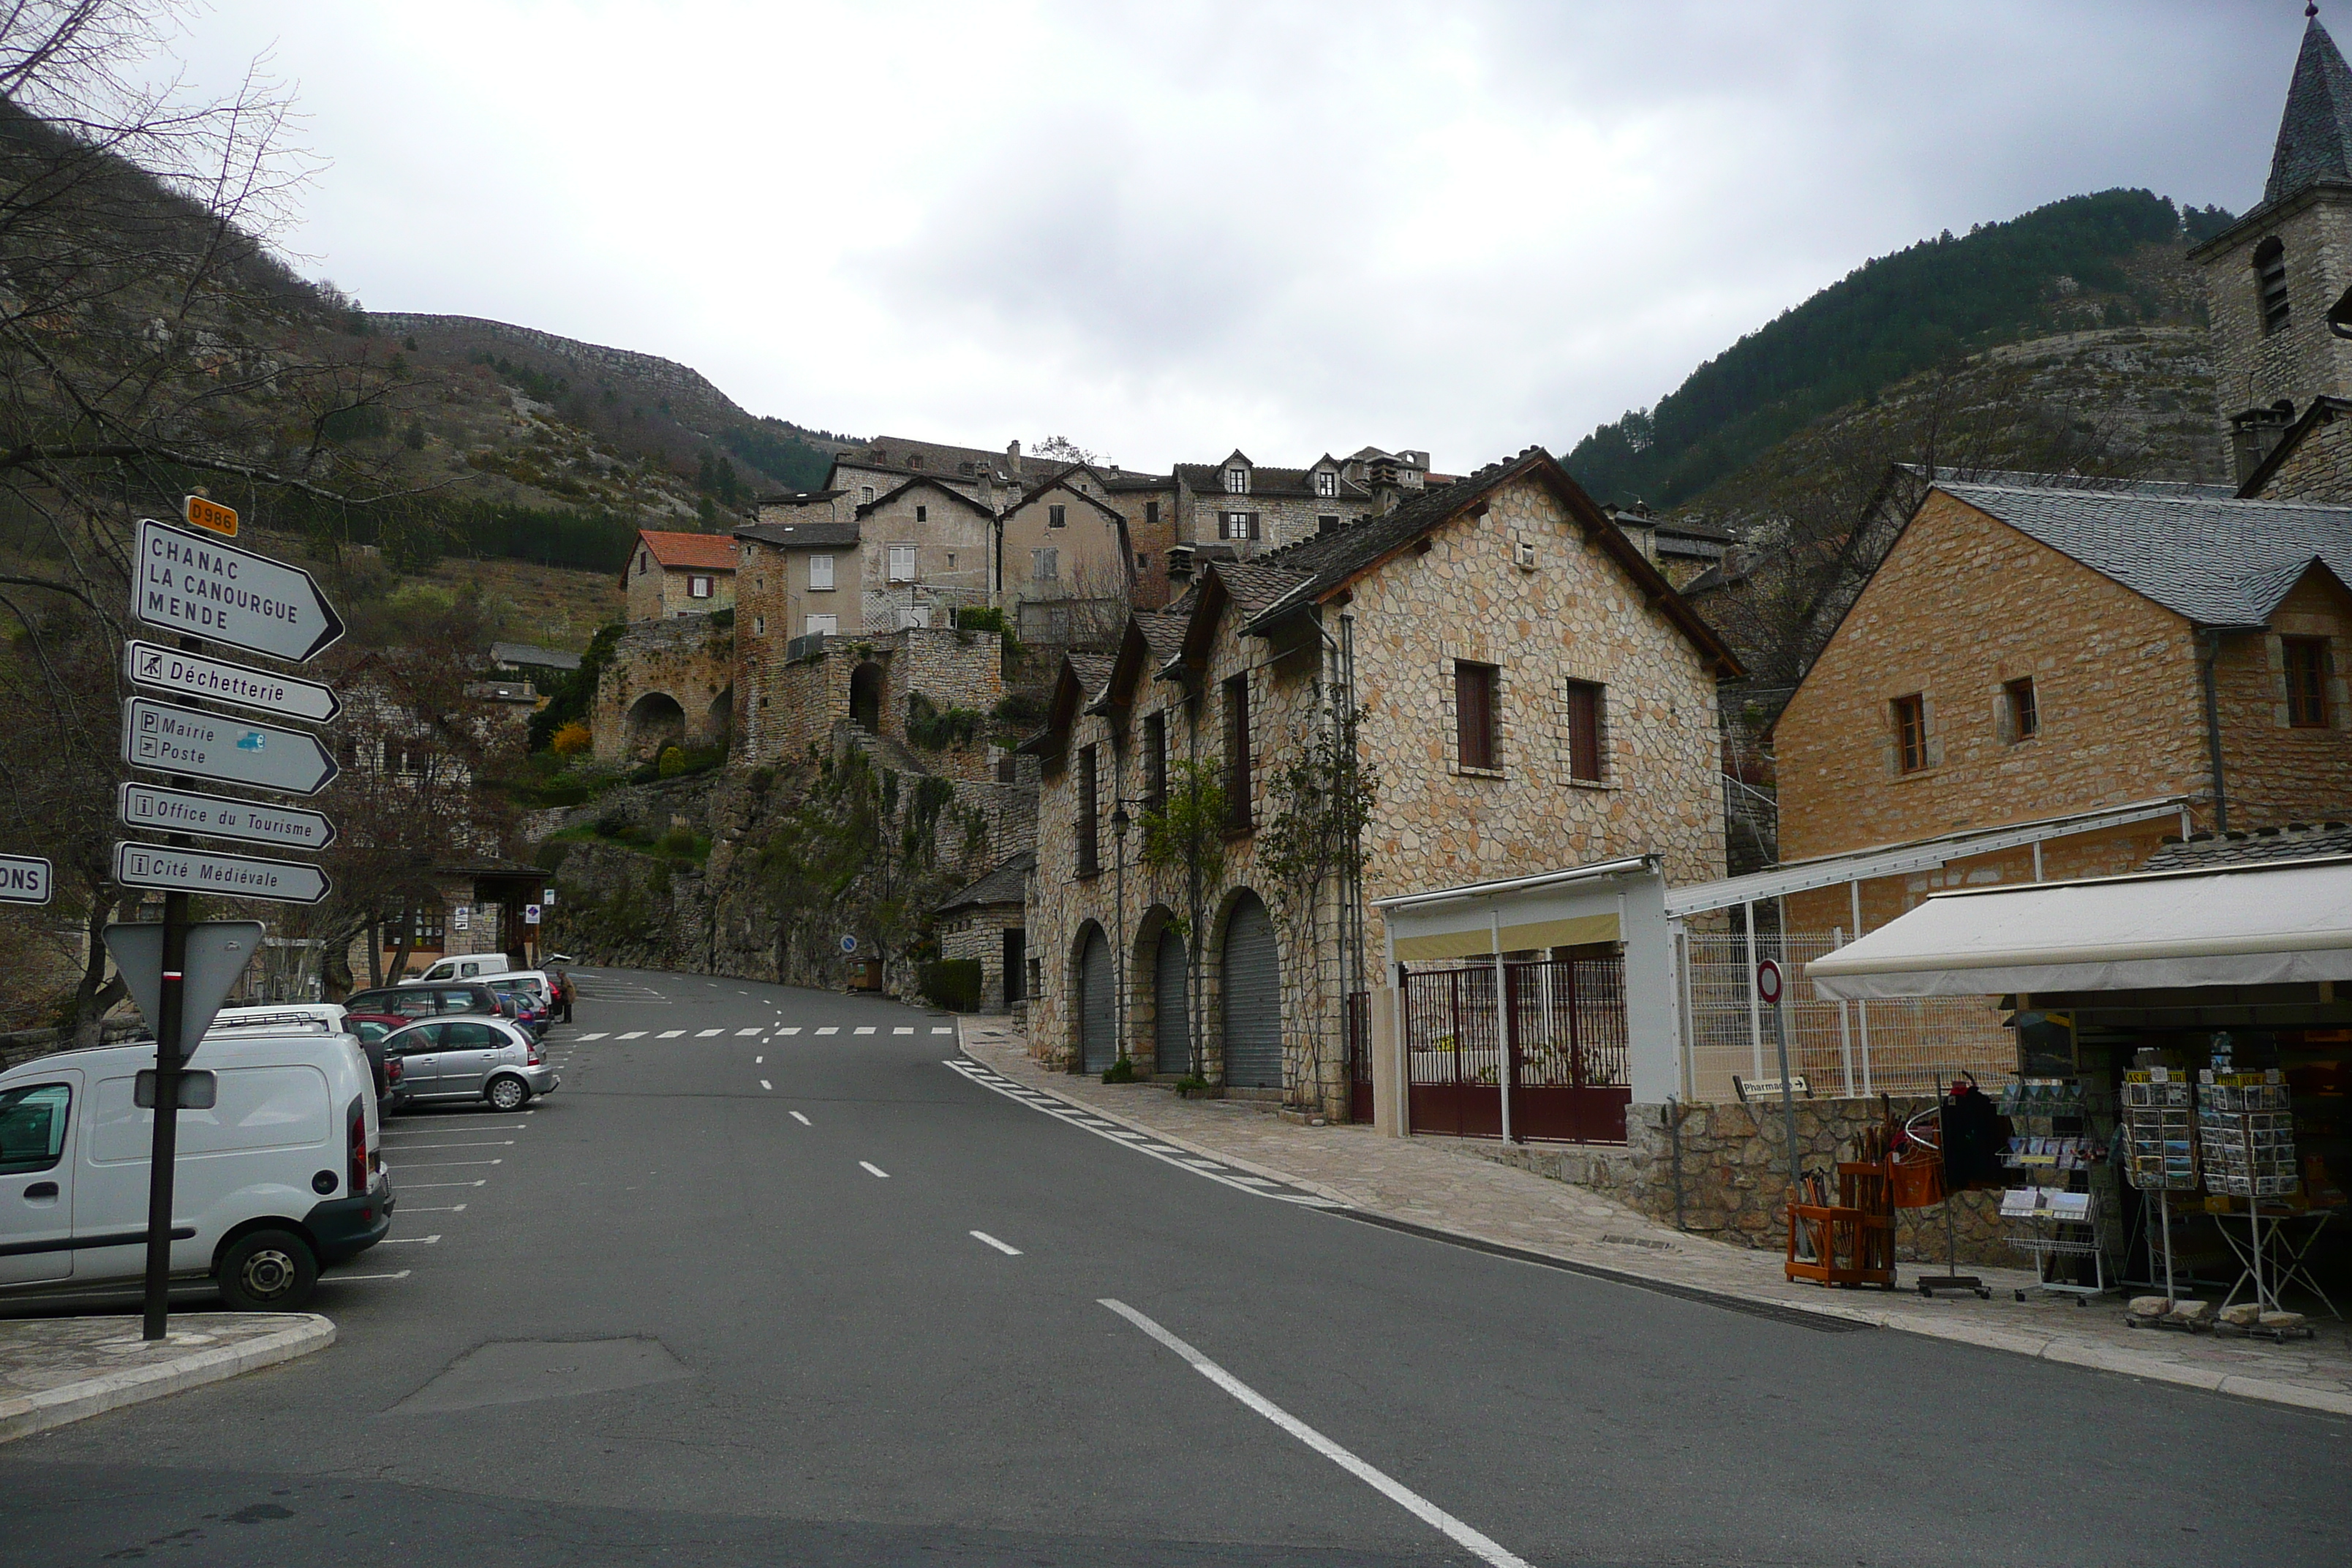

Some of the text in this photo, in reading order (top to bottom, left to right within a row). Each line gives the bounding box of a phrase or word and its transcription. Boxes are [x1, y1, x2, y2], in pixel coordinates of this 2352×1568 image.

[151, 538, 238, 580] CHANAC
[150, 563, 298, 624] LA CANOURGUE
[148, 591, 227, 630] MENDE
[170, 661, 284, 701] Déchetterie
[162, 717, 214, 742] Mairie
[161, 741, 206, 764] Poste
[158, 801, 208, 823] Office
[219, 810, 236, 826] du
[249, 813, 312, 837] Tourisme
[0, 867, 39, 891] ONS
[153, 859, 188, 878] Cité
[200, 864, 278, 888] Médiévale
[1744, 1082, 1793, 1093] Pharmace
